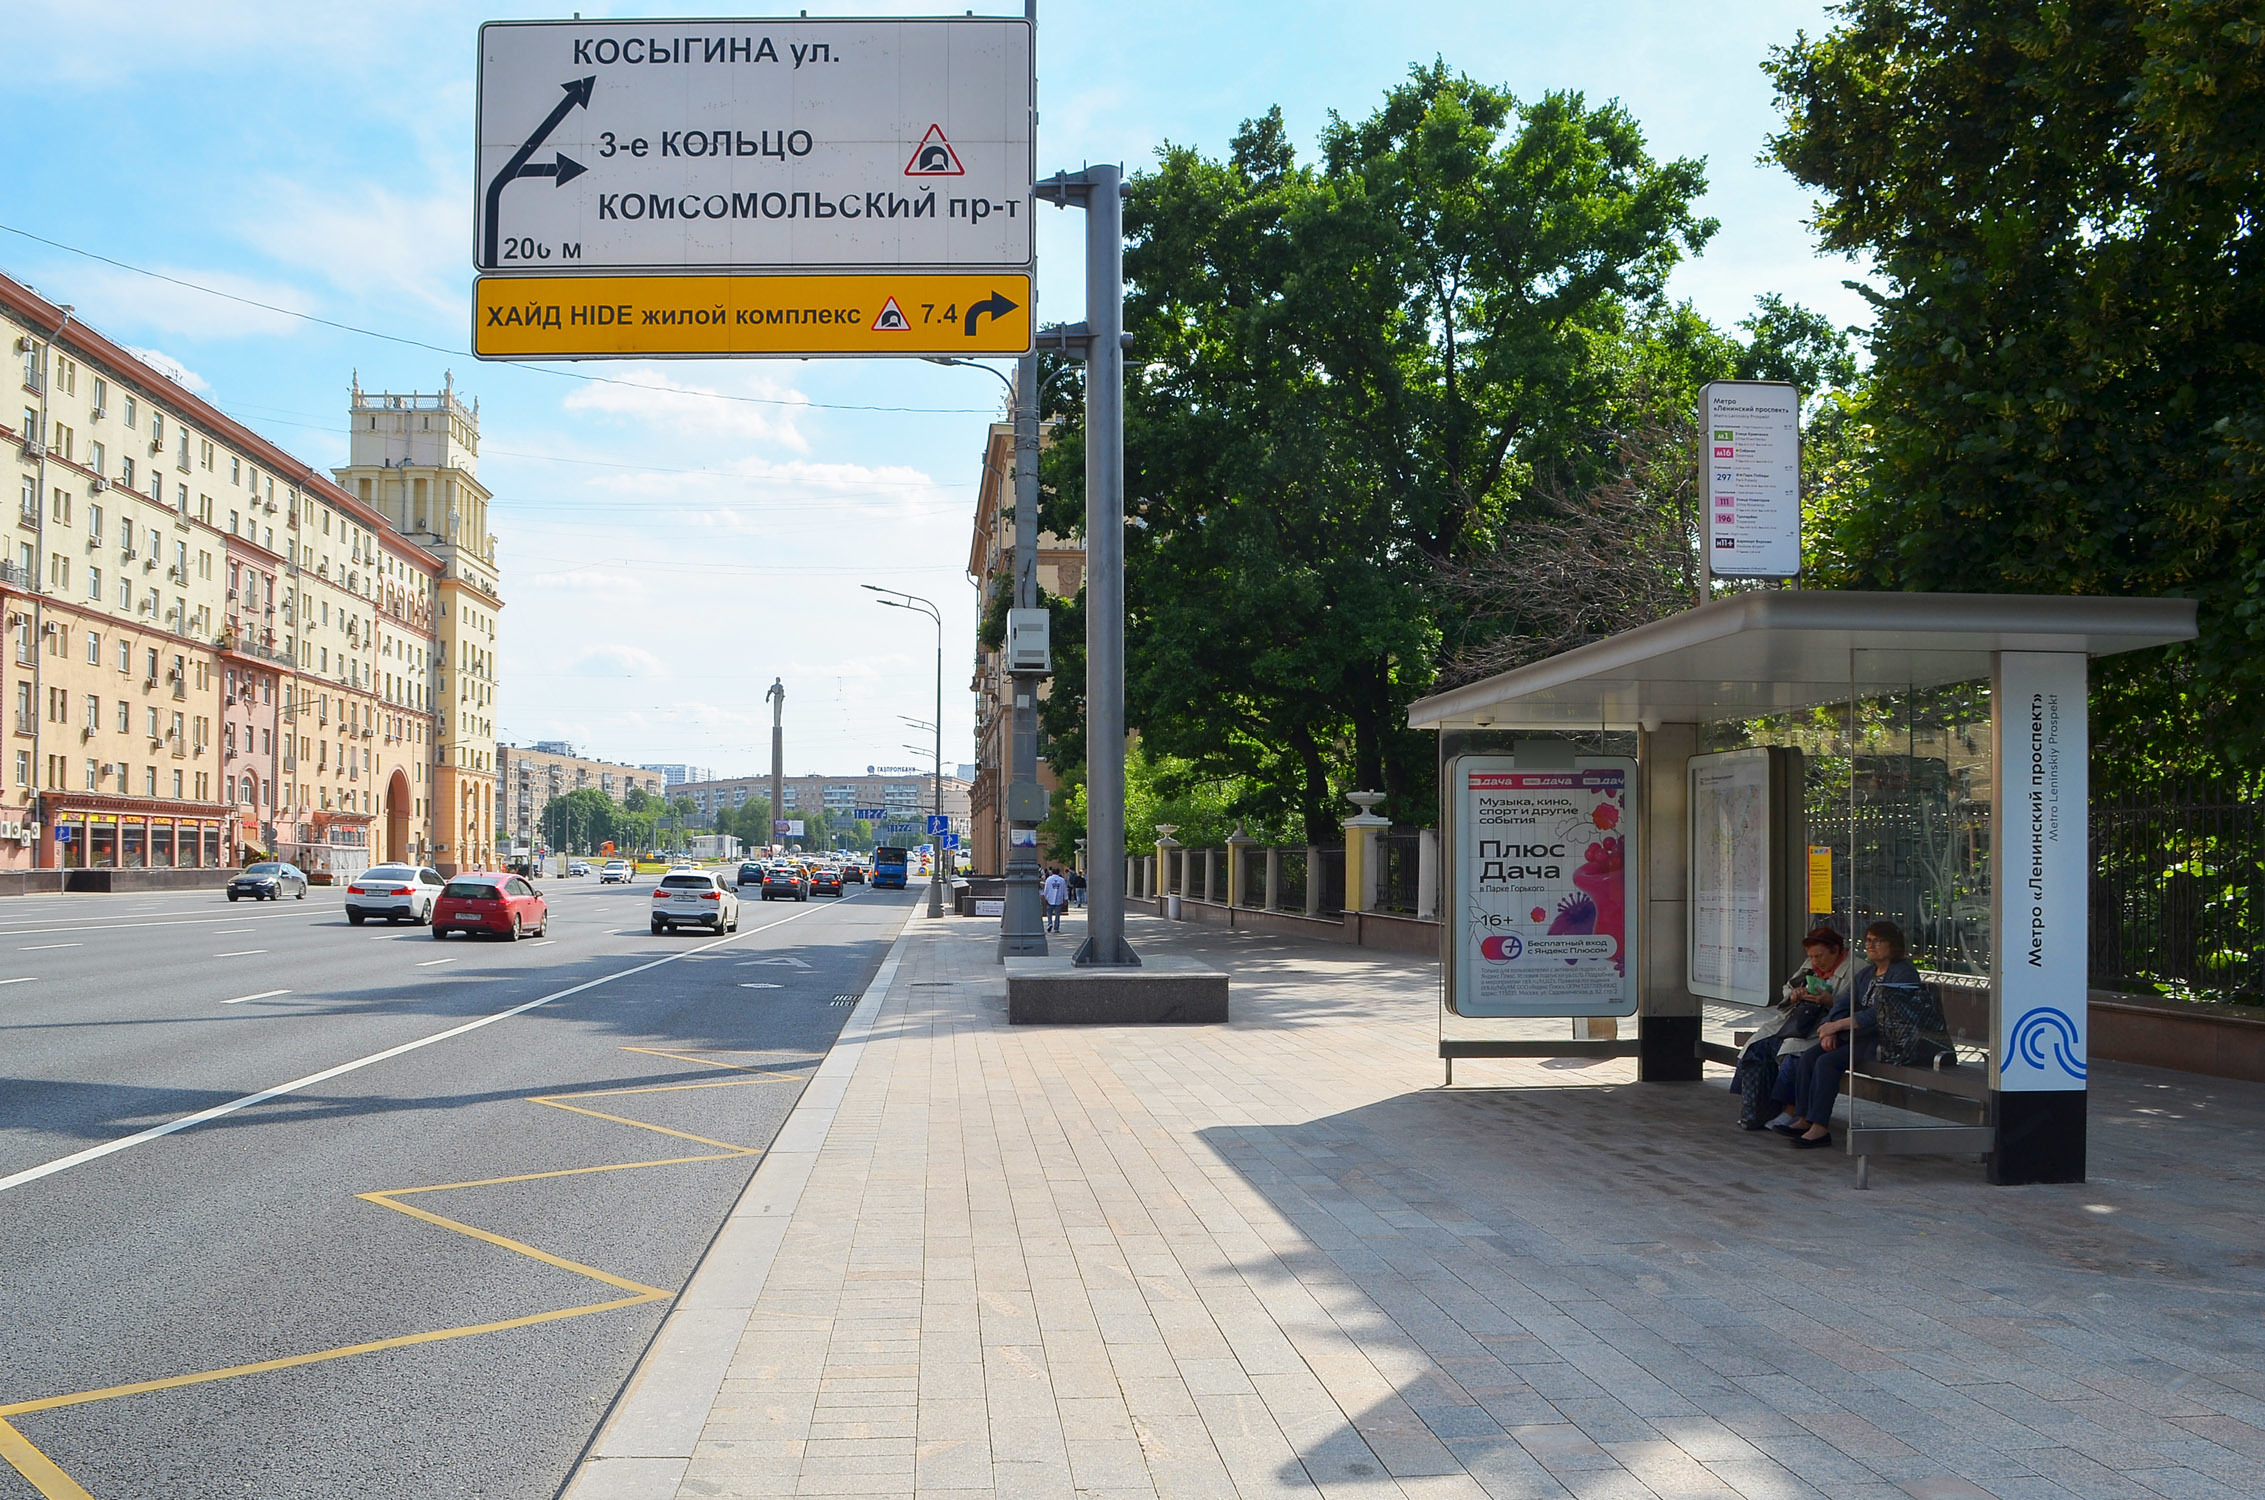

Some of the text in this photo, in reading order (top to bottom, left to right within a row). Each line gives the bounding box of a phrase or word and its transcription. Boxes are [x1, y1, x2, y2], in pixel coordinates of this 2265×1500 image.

[573, 37, 840, 69] КОСЫГИНА ул.
[599, 129, 813, 162] 3-е КОЛЬЦО
[599, 185, 1021, 225] КОМСОМОЛЬСКИЙ пр-т
[562, 242, 582, 259] м
[487, 301, 958, 329] ХАЙД HIDE жилой комплекс 7.4
[1713, 398, 1736, 406] Метро
[1716, 473, 1732, 481] 297
[1718, 515, 1732, 523] 196
[2048, 694, 2060, 842] Metro Leninskiy Prospekt
[1479, 798, 1572, 807] Музыка, кино,
[1479, 807, 1518, 817] спорт
[1532, 808, 1578, 817] другие
[1479, 816, 1536, 824] события
[2028, 694, 2045, 968] Метро «Ленинский проспект»
[1480, 840, 1565, 858] Плюс
[1480, 862, 1560, 884] Дача
[1486, 885, 1509, 893] Парке
[1510, 885, 1544, 893] Горького
[1480, 914, 1513, 926] 16+
[1528, 940, 1608, 948] Бесплатный вход
